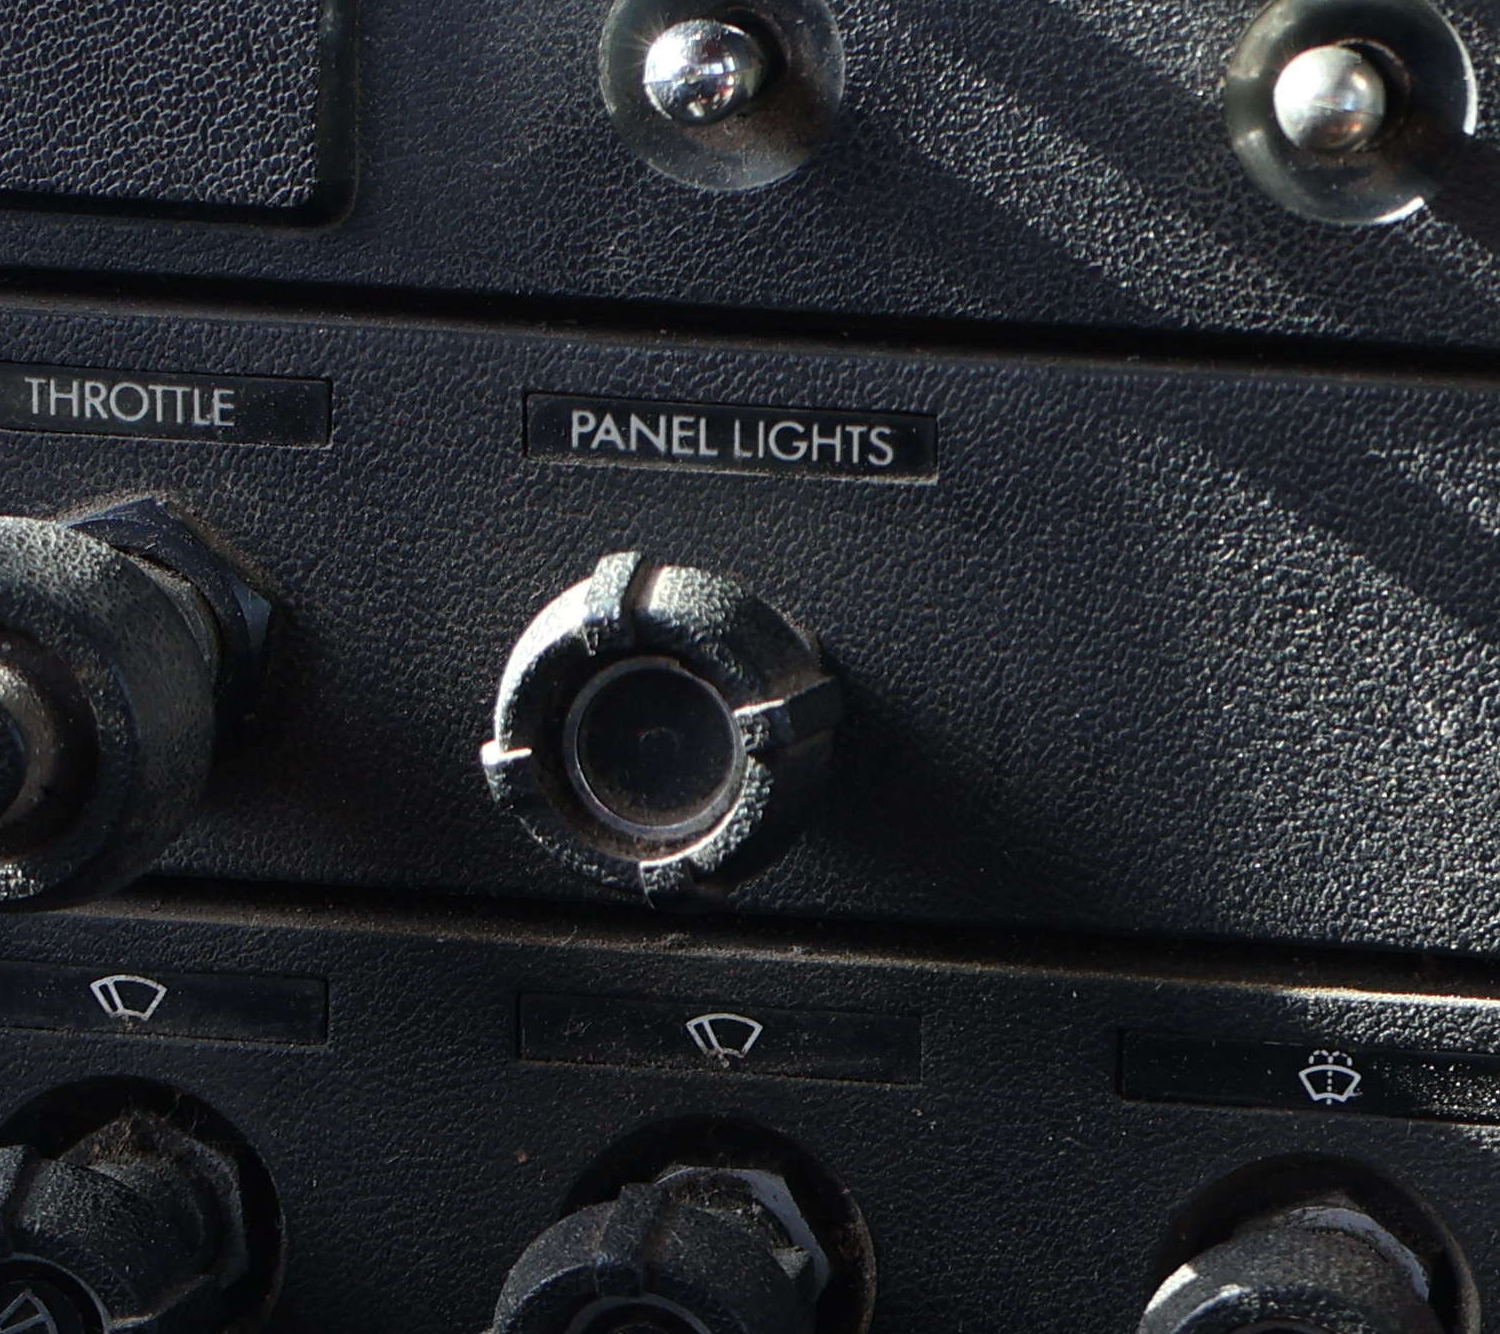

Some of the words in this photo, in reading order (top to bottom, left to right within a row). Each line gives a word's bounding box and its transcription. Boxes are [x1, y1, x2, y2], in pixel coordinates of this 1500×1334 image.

[24, 376, 236, 427] THROTTLE
[570, 409, 719, 457] PANEL
[733, 418, 895, 467] LIGHTS
